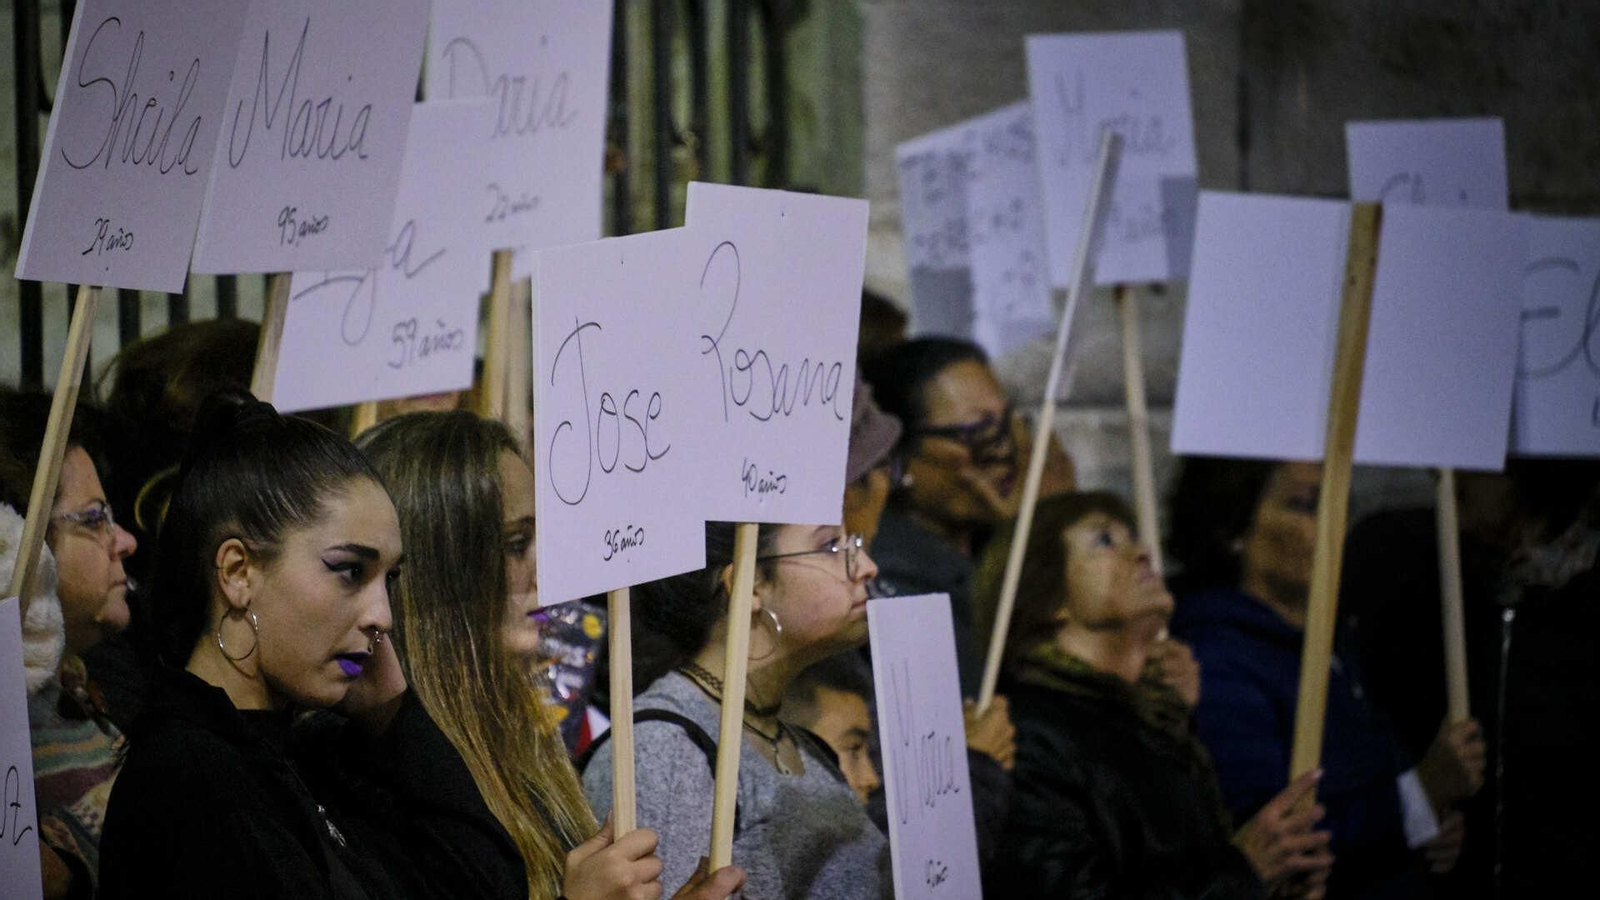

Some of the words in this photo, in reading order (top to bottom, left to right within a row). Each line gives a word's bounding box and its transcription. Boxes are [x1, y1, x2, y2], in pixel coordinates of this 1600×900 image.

[61, 16, 202, 175] Sheila
[228, 16, 374, 169] Maria
[278, 206, 297, 246] 95
[549, 316, 671, 506] Jose
[741, 457, 758, 498] 40
[603, 529, 620, 562] 36
